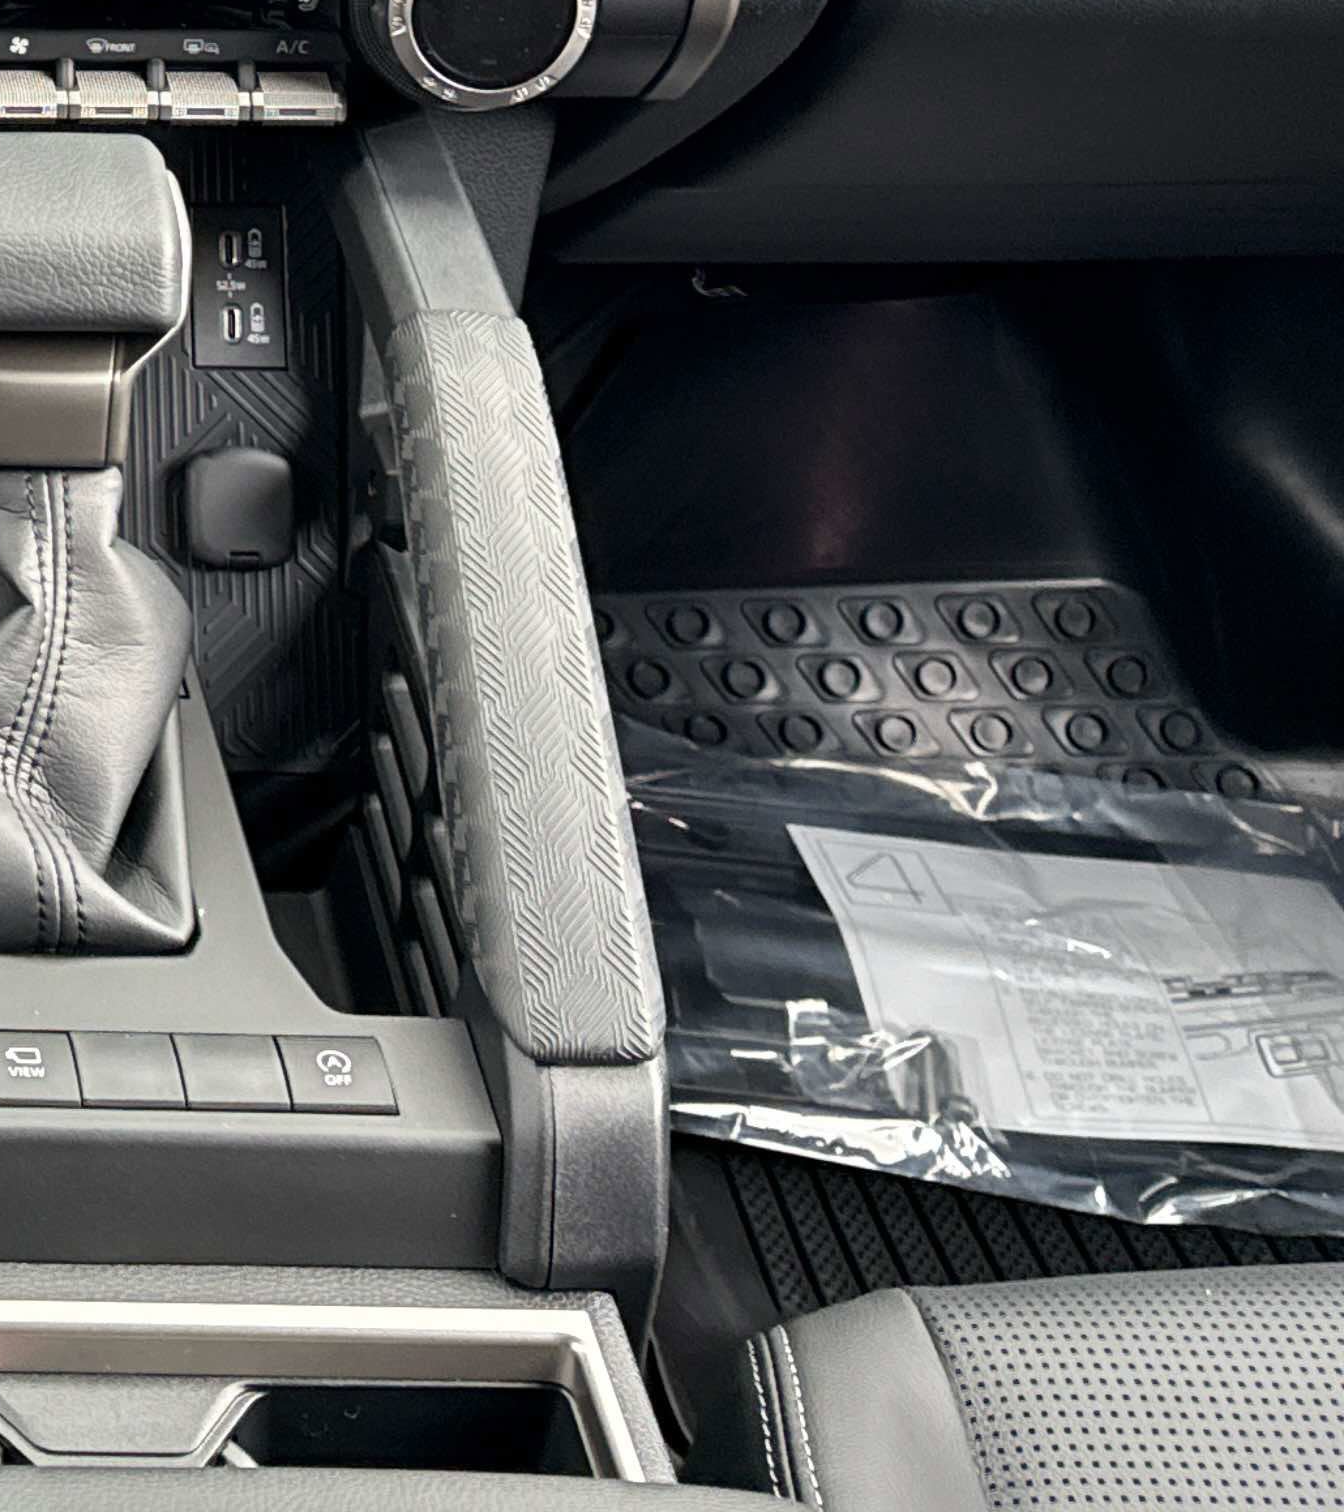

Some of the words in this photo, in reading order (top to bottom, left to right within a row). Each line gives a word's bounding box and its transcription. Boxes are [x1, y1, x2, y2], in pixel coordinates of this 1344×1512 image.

[276, 40, 310, 55] A/C
[8, 1067, 45, 1078] VIEW
[324, 1074, 352, 1086] OFF
